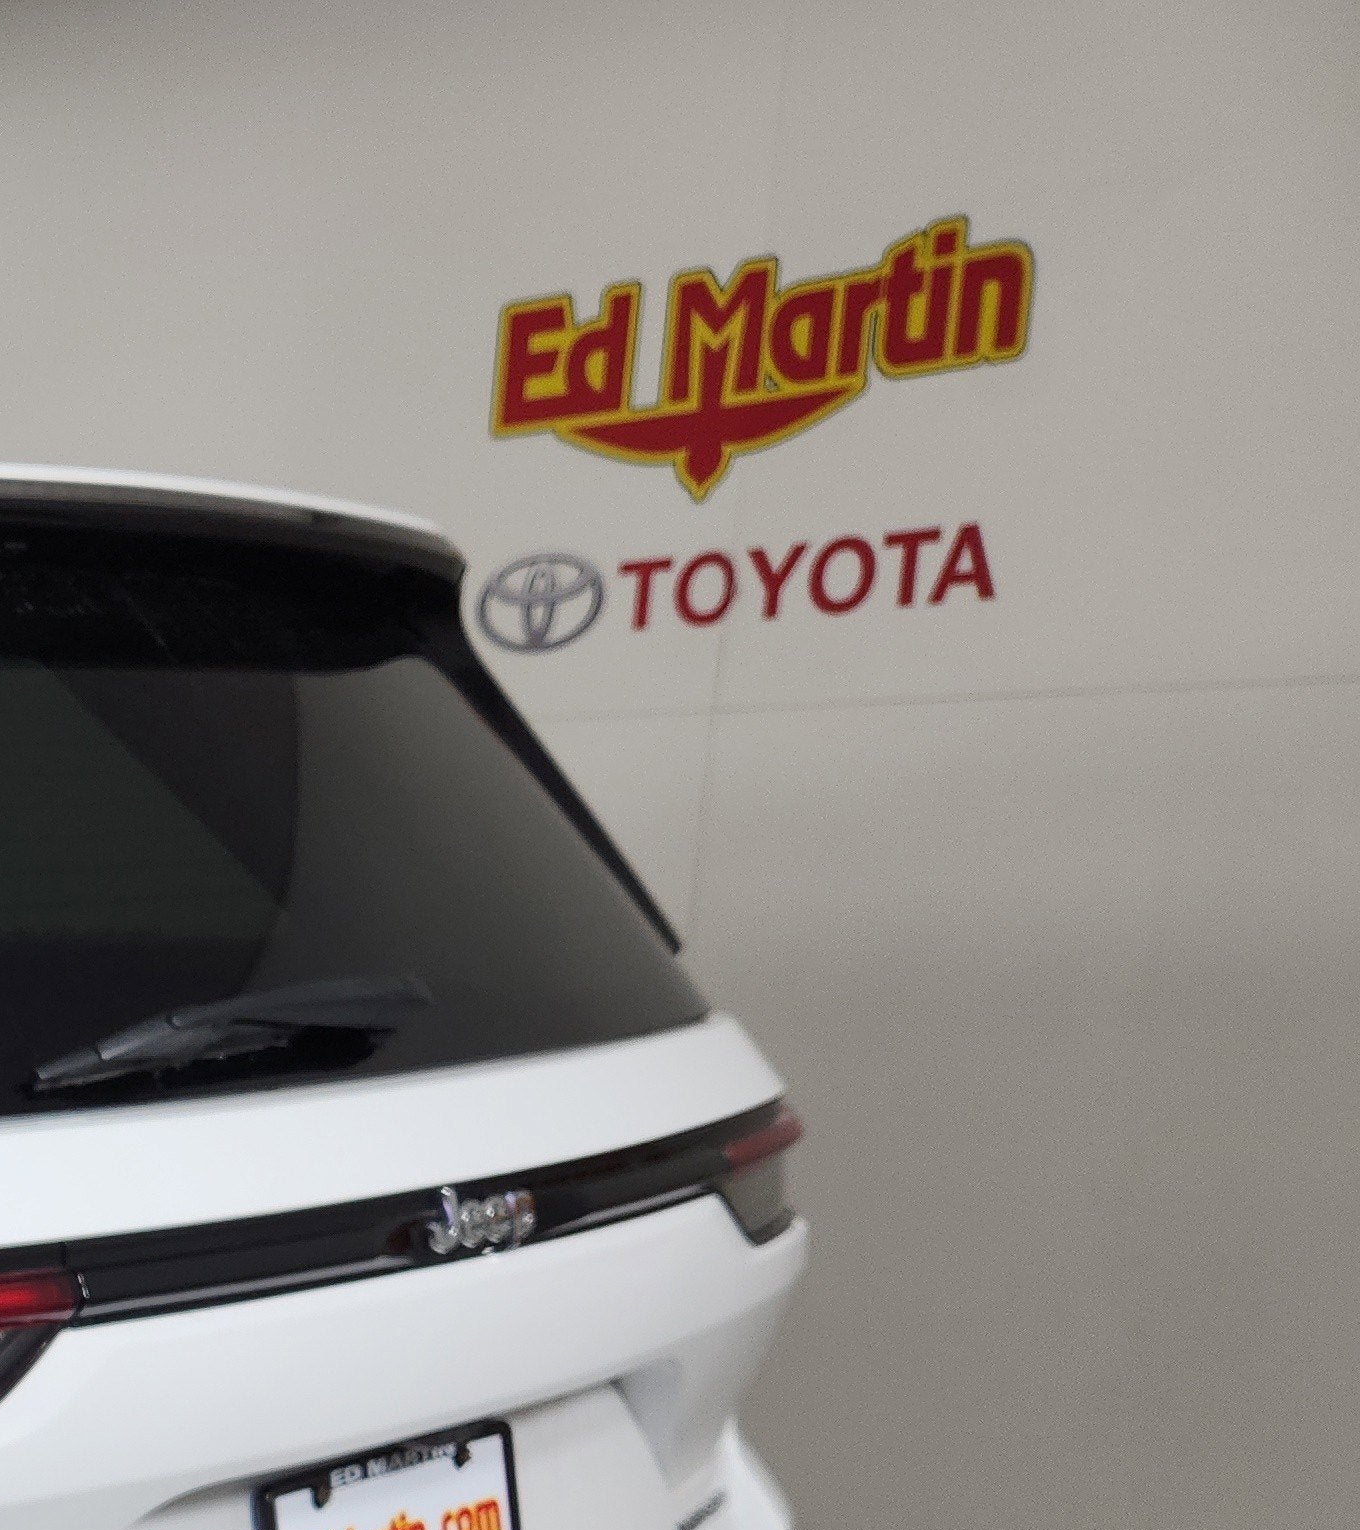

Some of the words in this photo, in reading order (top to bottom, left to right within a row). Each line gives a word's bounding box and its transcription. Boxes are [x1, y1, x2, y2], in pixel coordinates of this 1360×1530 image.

[492, 280, 641, 439] Ed
[660, 215, 1034, 408] Martin
[622, 524, 994, 630] TOYOTA
